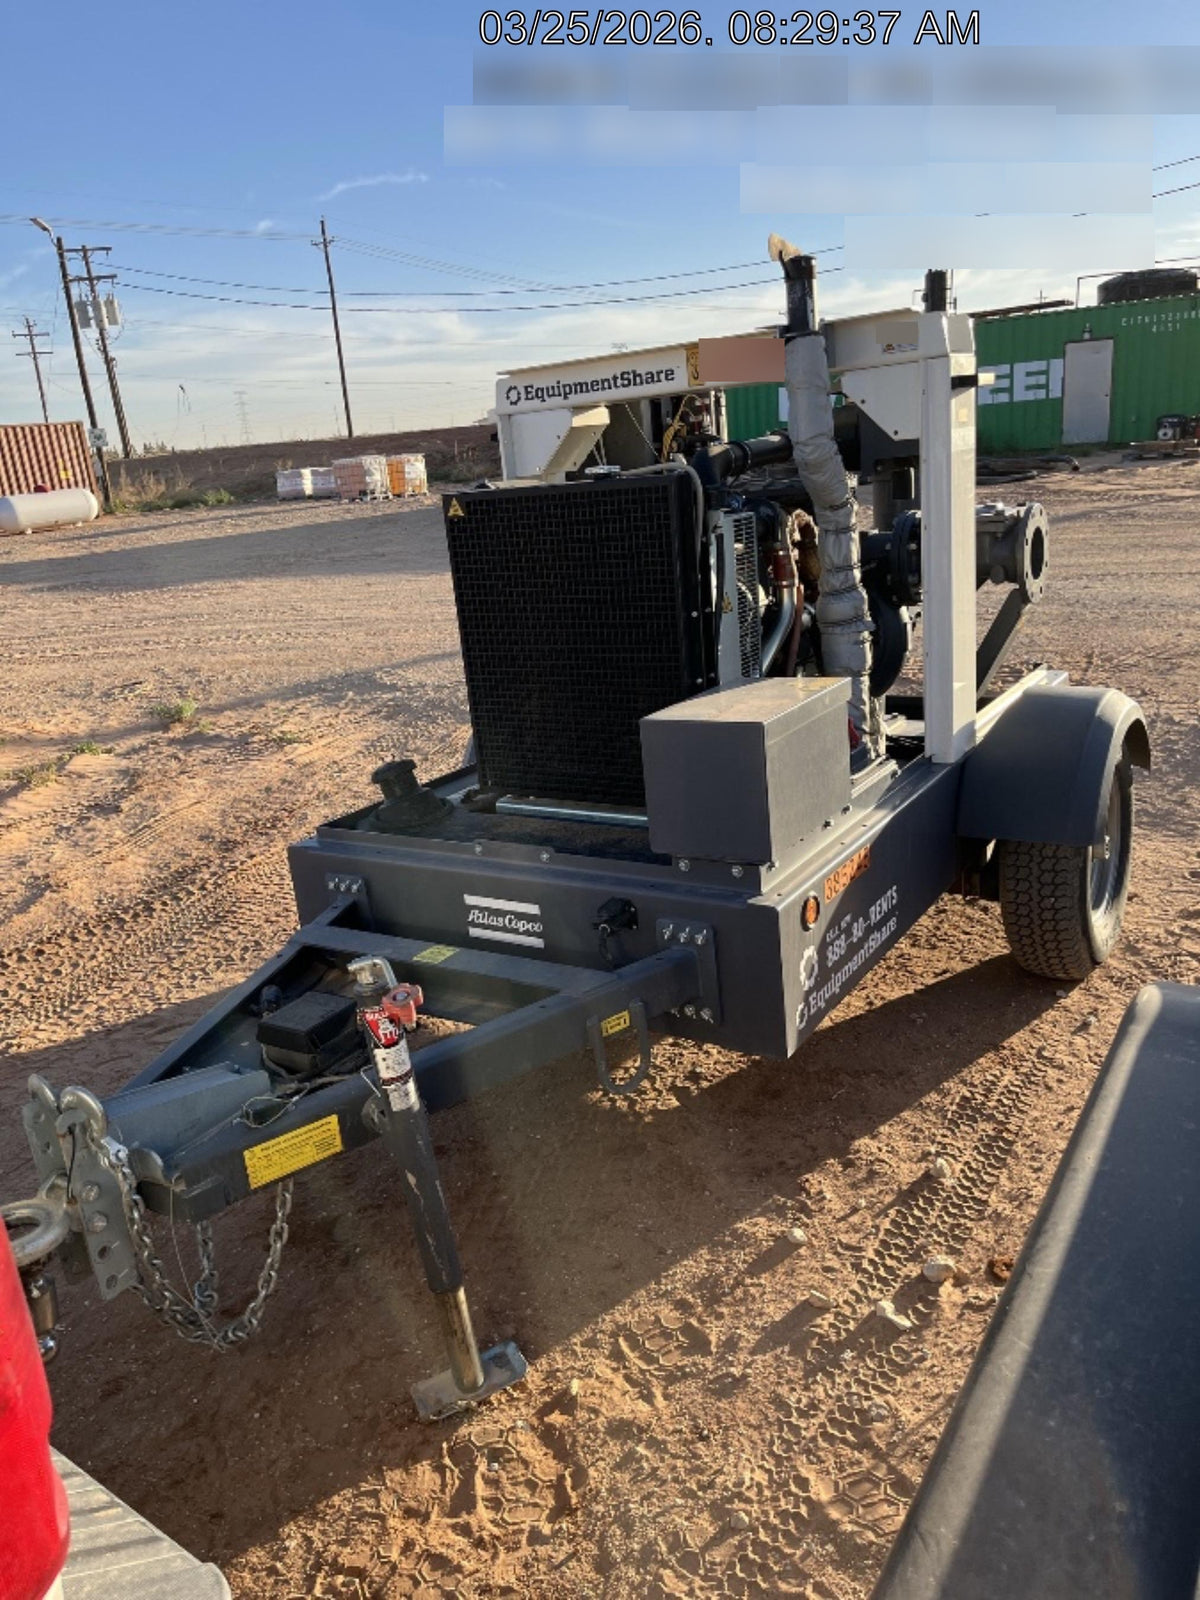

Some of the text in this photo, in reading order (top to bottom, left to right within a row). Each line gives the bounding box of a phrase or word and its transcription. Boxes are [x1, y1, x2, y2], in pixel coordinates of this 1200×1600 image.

[523, 367, 676, 402] EquipmentShare
[467, 909, 543, 932] Atlas Copco
[808, 917, 898, 1015] EquipmentShare
